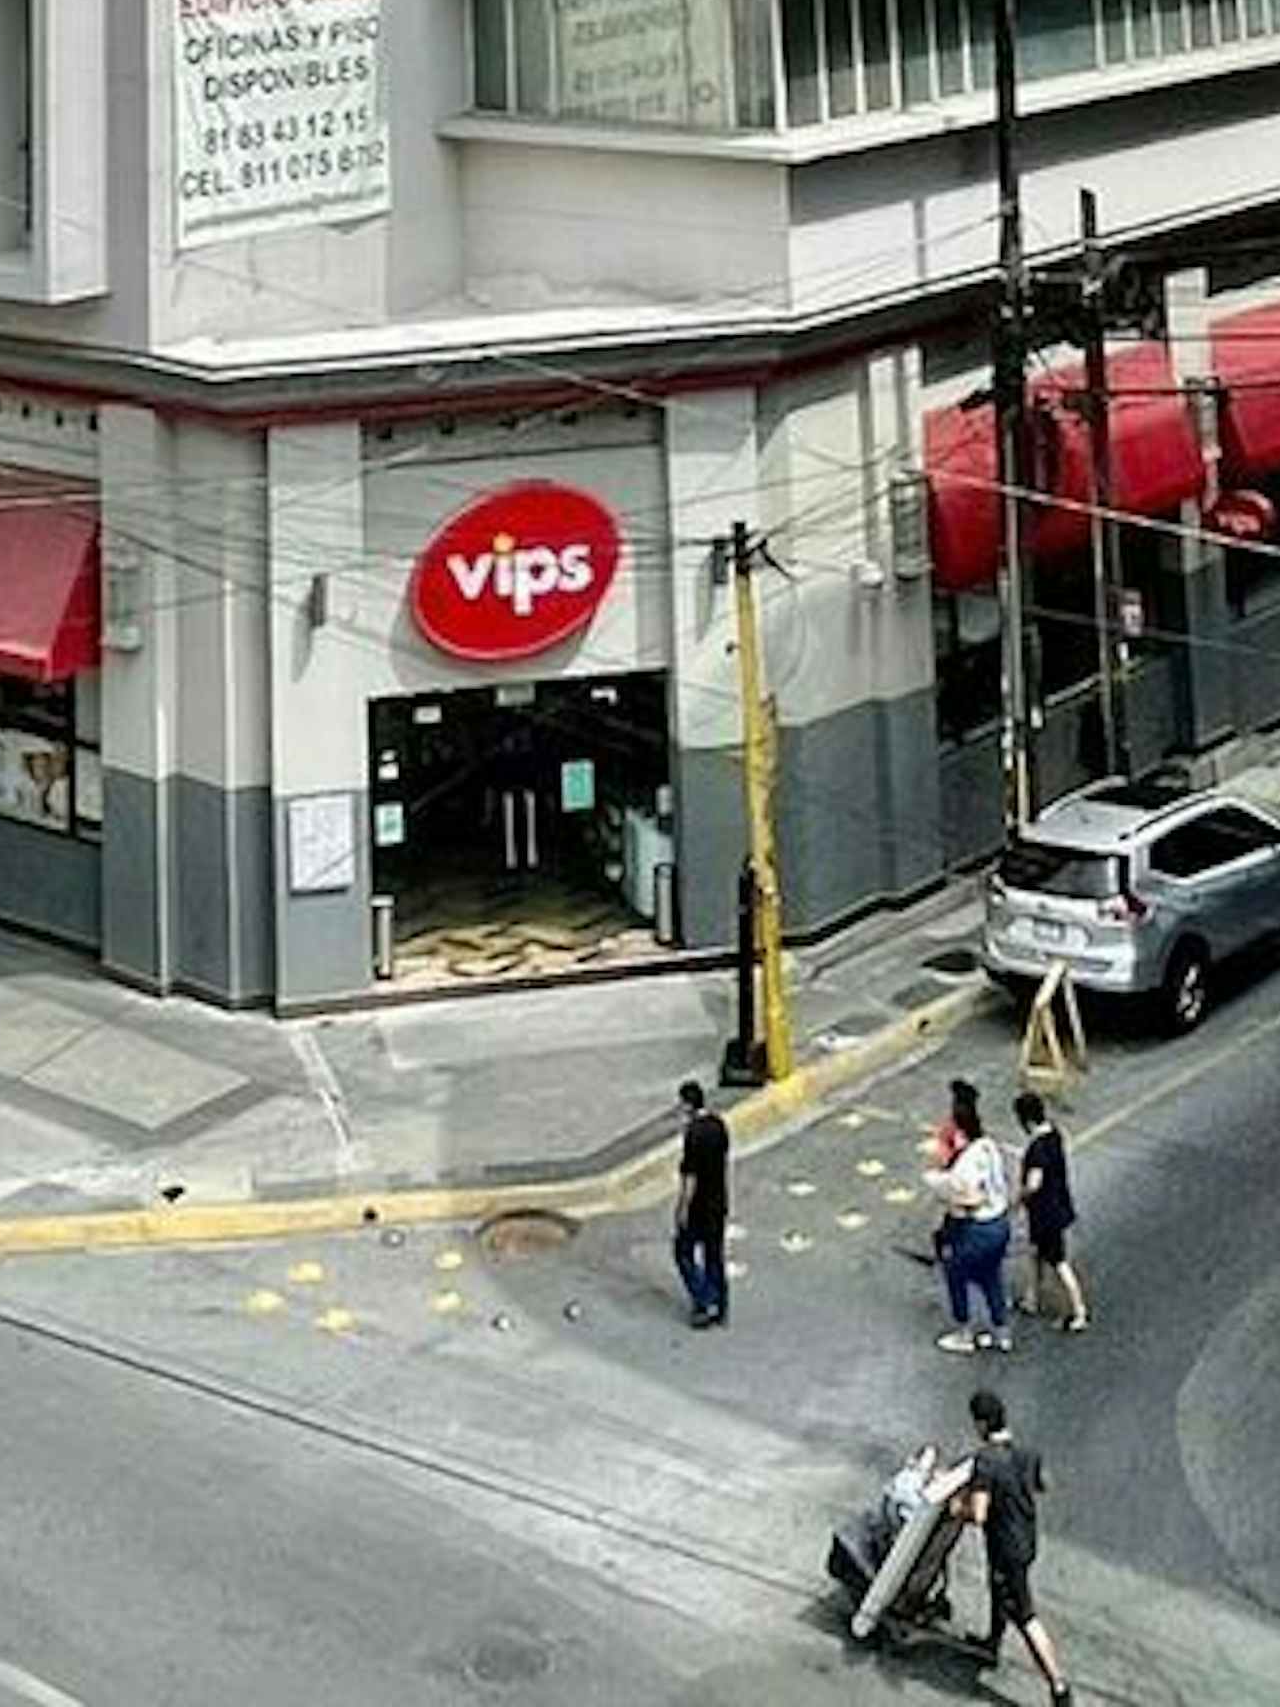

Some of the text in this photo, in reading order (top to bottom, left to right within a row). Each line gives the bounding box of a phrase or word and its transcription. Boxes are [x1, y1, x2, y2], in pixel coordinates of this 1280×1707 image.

[183, 25, 300, 64] OFICINAS
[306, 23, 324, 48] Y
[204, 54, 370, 103] DISPONIBLES
[446, 531, 595, 615] vips
